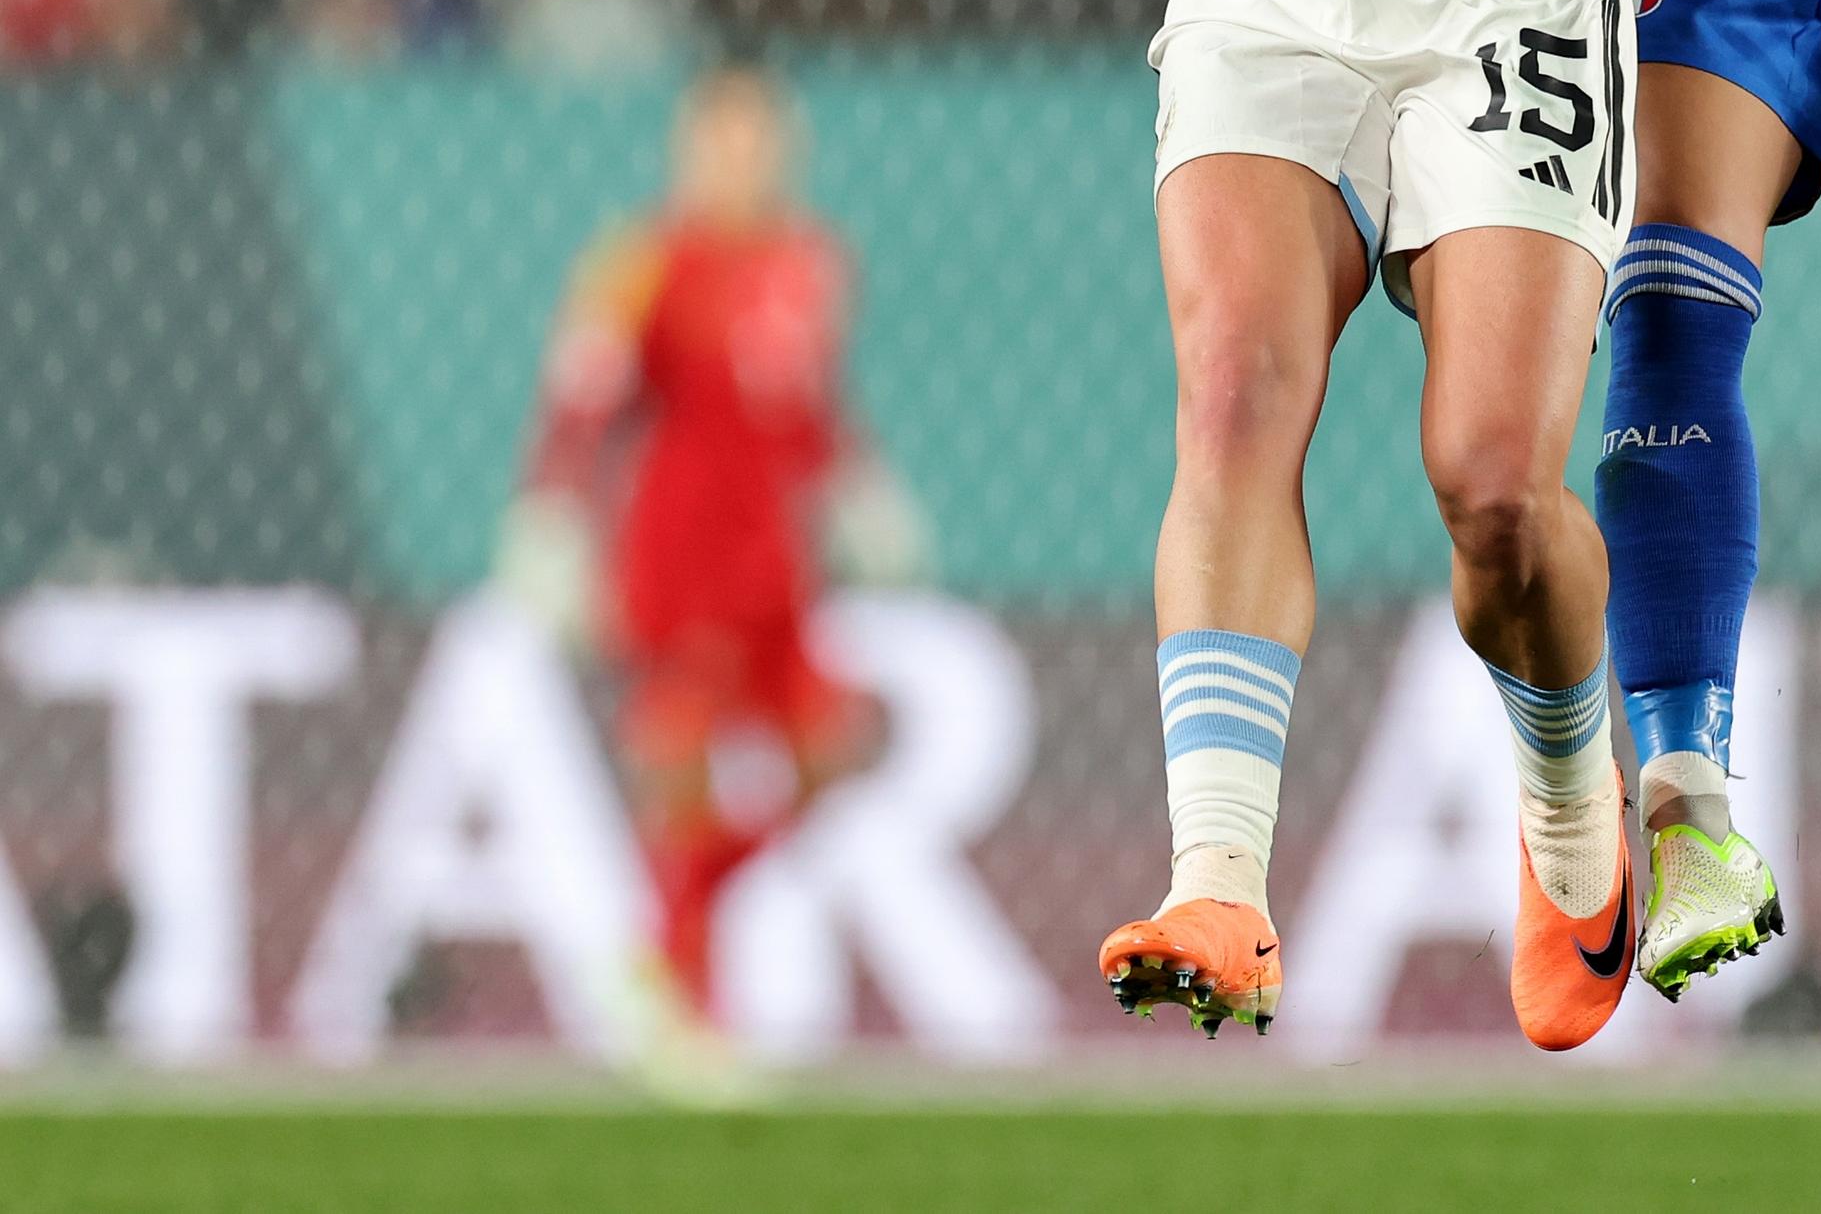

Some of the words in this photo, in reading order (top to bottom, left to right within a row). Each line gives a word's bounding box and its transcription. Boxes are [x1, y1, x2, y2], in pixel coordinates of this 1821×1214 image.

[1467, 27, 1595, 152] 15
[1602, 424, 1711, 457] ITALIA
[0, 594, 1055, 1068] TAR
